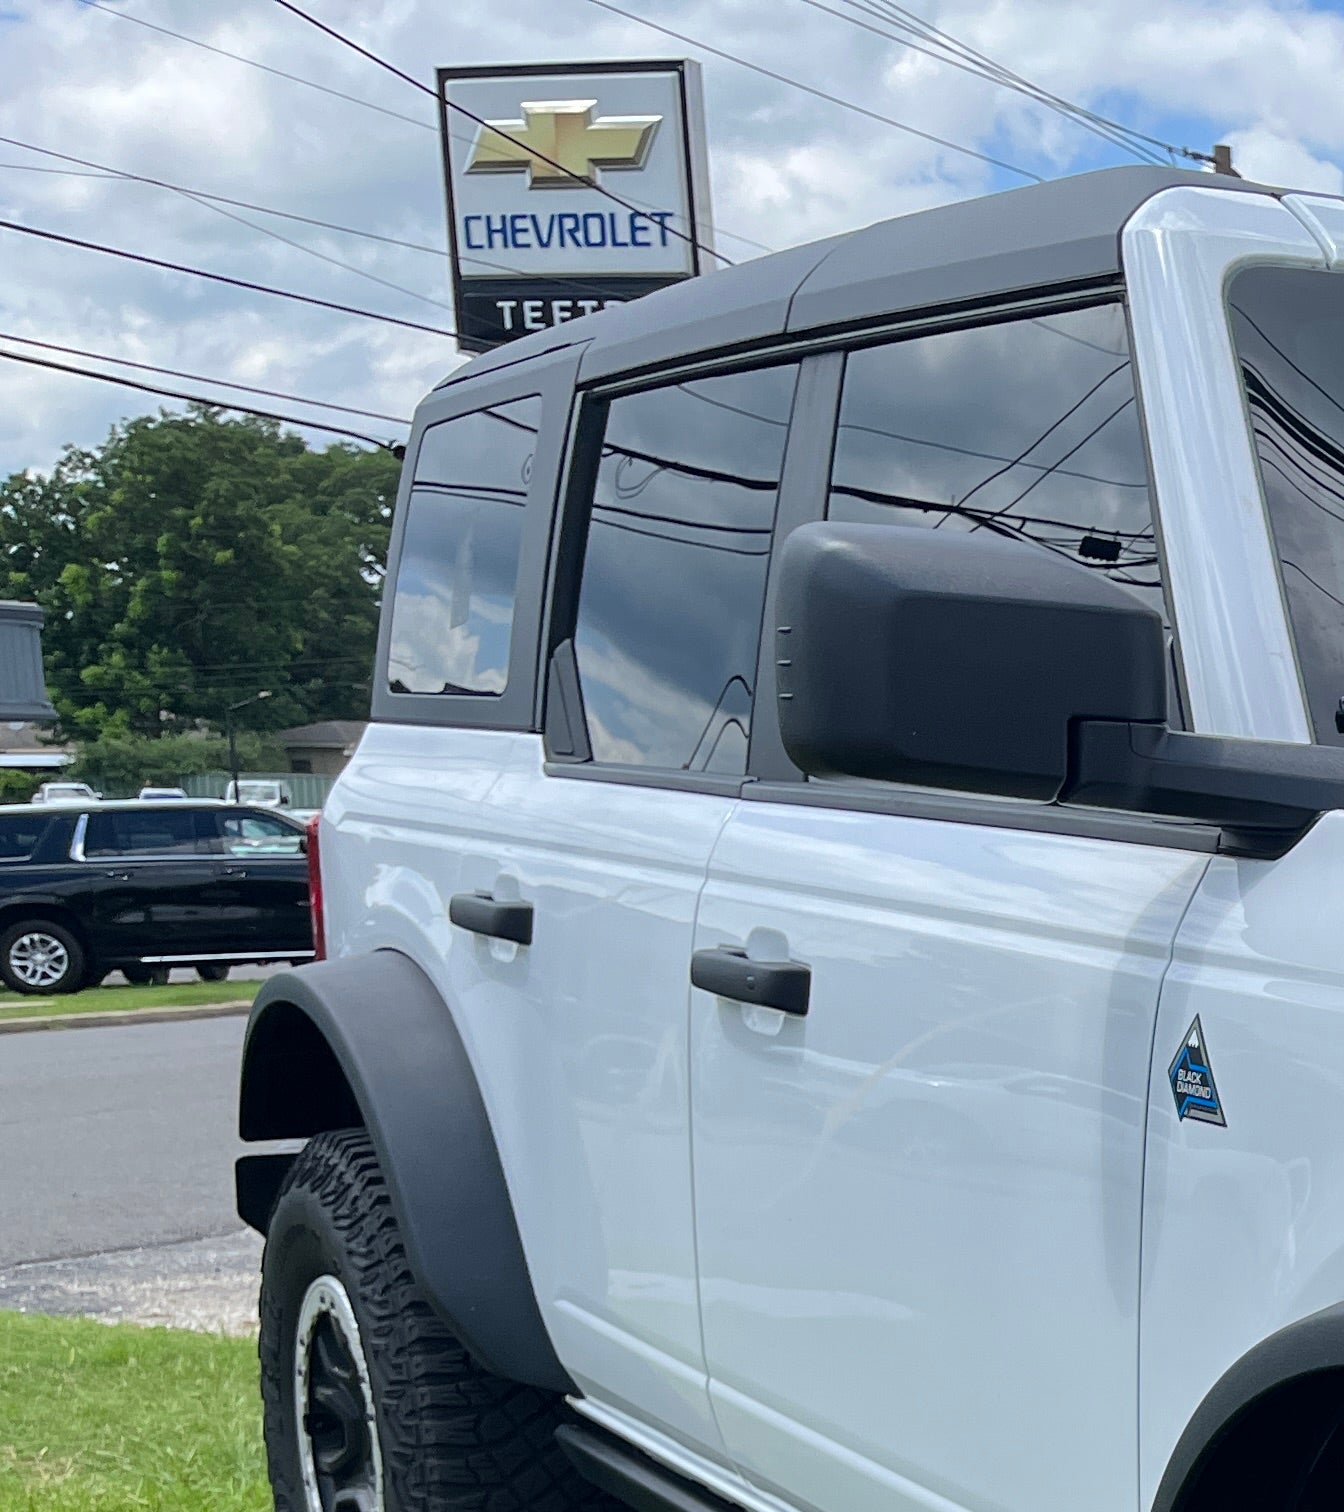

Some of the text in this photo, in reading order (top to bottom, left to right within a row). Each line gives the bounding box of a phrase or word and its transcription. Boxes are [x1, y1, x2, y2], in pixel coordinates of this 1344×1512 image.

[463, 211, 674, 250] CHEVROLET
[1177, 1068, 1202, 1085] BLACK
[1176, 1080, 1211, 1099] DIAMOND
